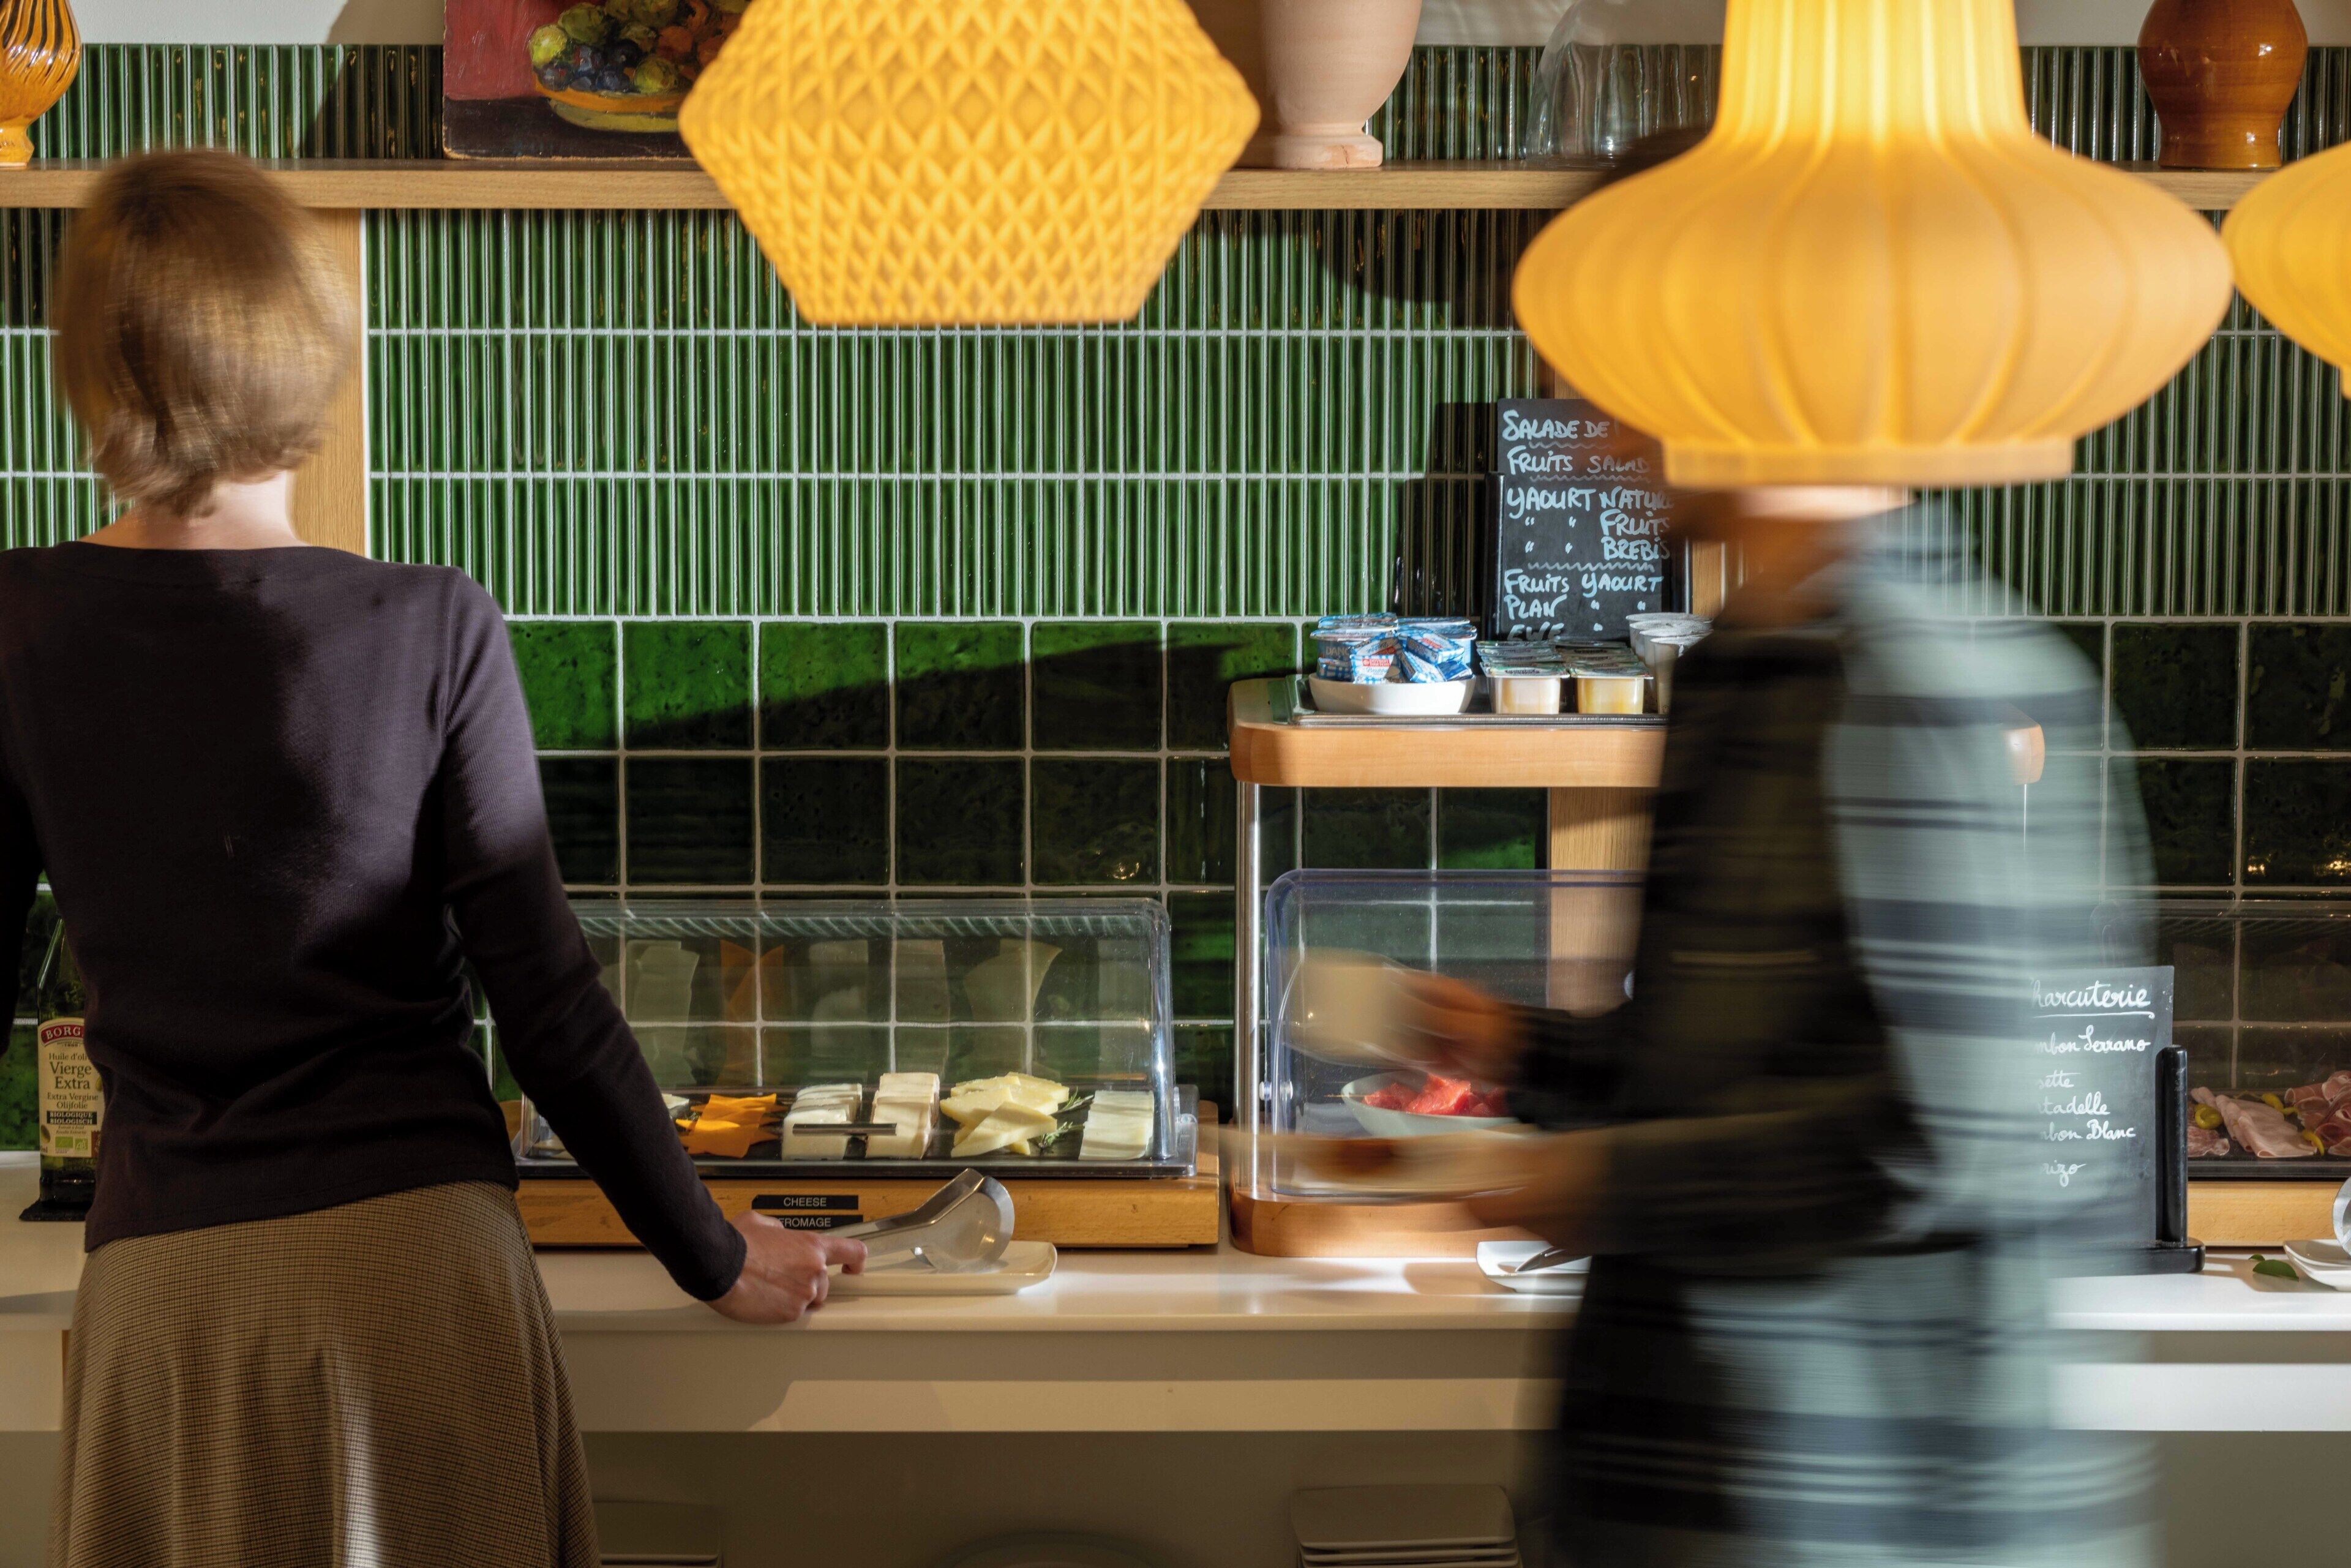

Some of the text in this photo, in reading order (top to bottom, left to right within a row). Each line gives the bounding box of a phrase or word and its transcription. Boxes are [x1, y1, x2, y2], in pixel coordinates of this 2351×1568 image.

[1502, 410, 1580, 441] SALADE
[1584, 421, 1610, 438] DE
[1508, 487, 1596, 519] YAOURT
[1581, 572, 1663, 598] YAOURT
[1504, 594, 1567, 620] PLAN
[2031, 980, 2151, 1008] harcuterie
[47, 1026, 83, 1040] BORG
[2034, 1024, 2151, 1055] mbon Serrano
[50, 1061, 91, 1078] Vierge
[2037, 1070, 2082, 1090] sette
[54, 1076, 90, 1089] Extra
[47, 1092, 98, 1103] Extra Vergine
[56, 1101, 88, 1110] Olijfolie
[2038, 1091, 2110, 1115] tadelle
[2086, 1119, 2136, 1141] Blanc
[2042, 1160, 2087, 1187] rizo
[784, 1197, 827, 1207] CHEESE
[778, 1217, 831, 1227] FROMAGE
